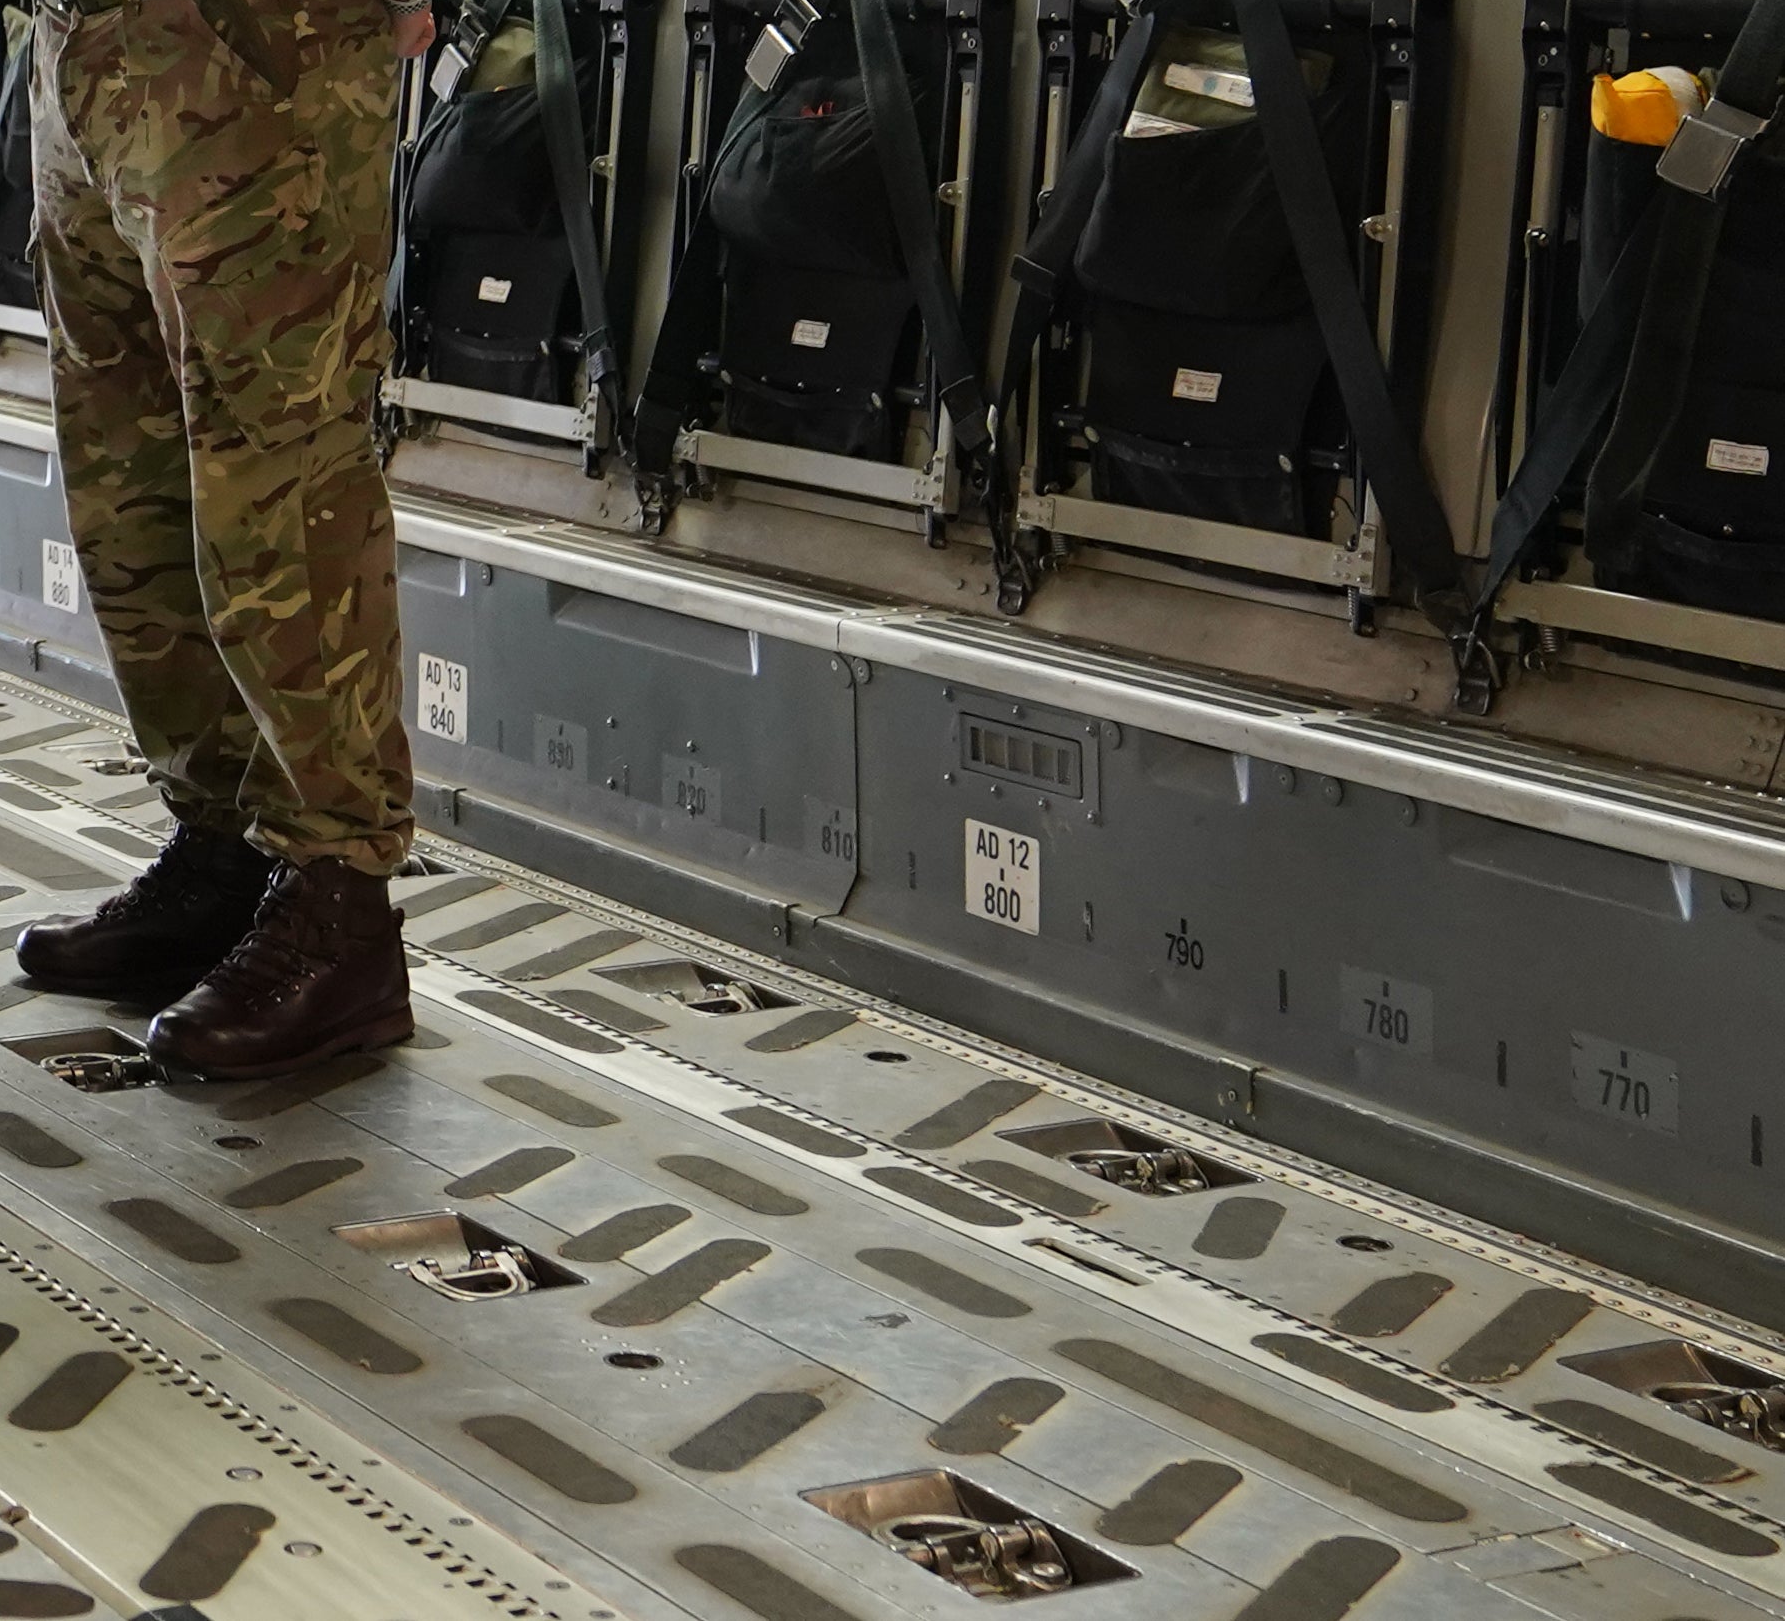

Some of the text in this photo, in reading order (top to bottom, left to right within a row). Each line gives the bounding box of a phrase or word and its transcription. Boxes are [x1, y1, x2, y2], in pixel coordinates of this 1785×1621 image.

[47, 545, 59, 565] AD
[425, 660, 461, 692] AD 13
[430, 704, 455, 736] 840
[821, 825, 853, 862] 810
[976, 828, 1029, 870] AD 12
[984, 882, 1021, 923] 800
[1165, 931, 1204, 971] 790
[1362, 998, 1409, 1044] 780
[1598, 1069, 1650, 1121] 770
